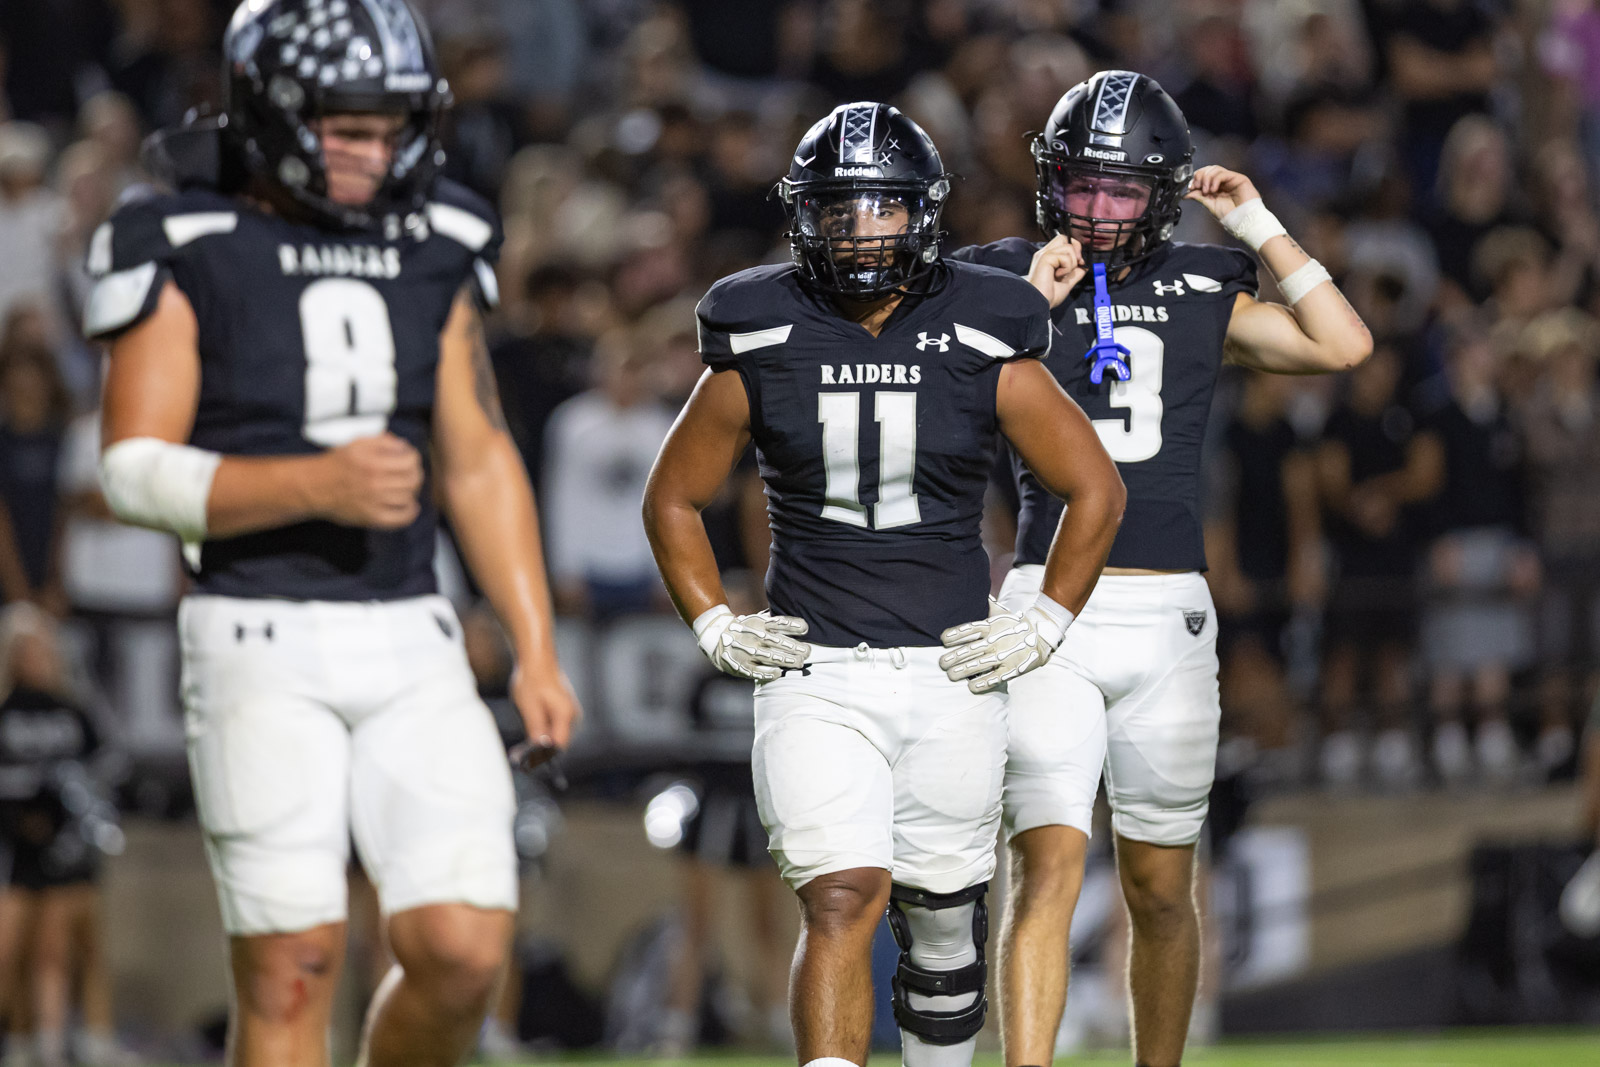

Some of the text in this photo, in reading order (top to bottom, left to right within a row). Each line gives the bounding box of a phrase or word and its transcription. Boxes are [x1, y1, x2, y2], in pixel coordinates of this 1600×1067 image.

[1084, 147, 1126, 161] Riddell
[1074, 304, 1170, 325] RIDERS
[1096, 305, 1113, 339] NXTRND
[299, 276, 399, 447] 8
[820, 364, 922, 385] RAIDERS
[1091, 326, 1164, 463] 3
[818, 390, 922, 530] 11
